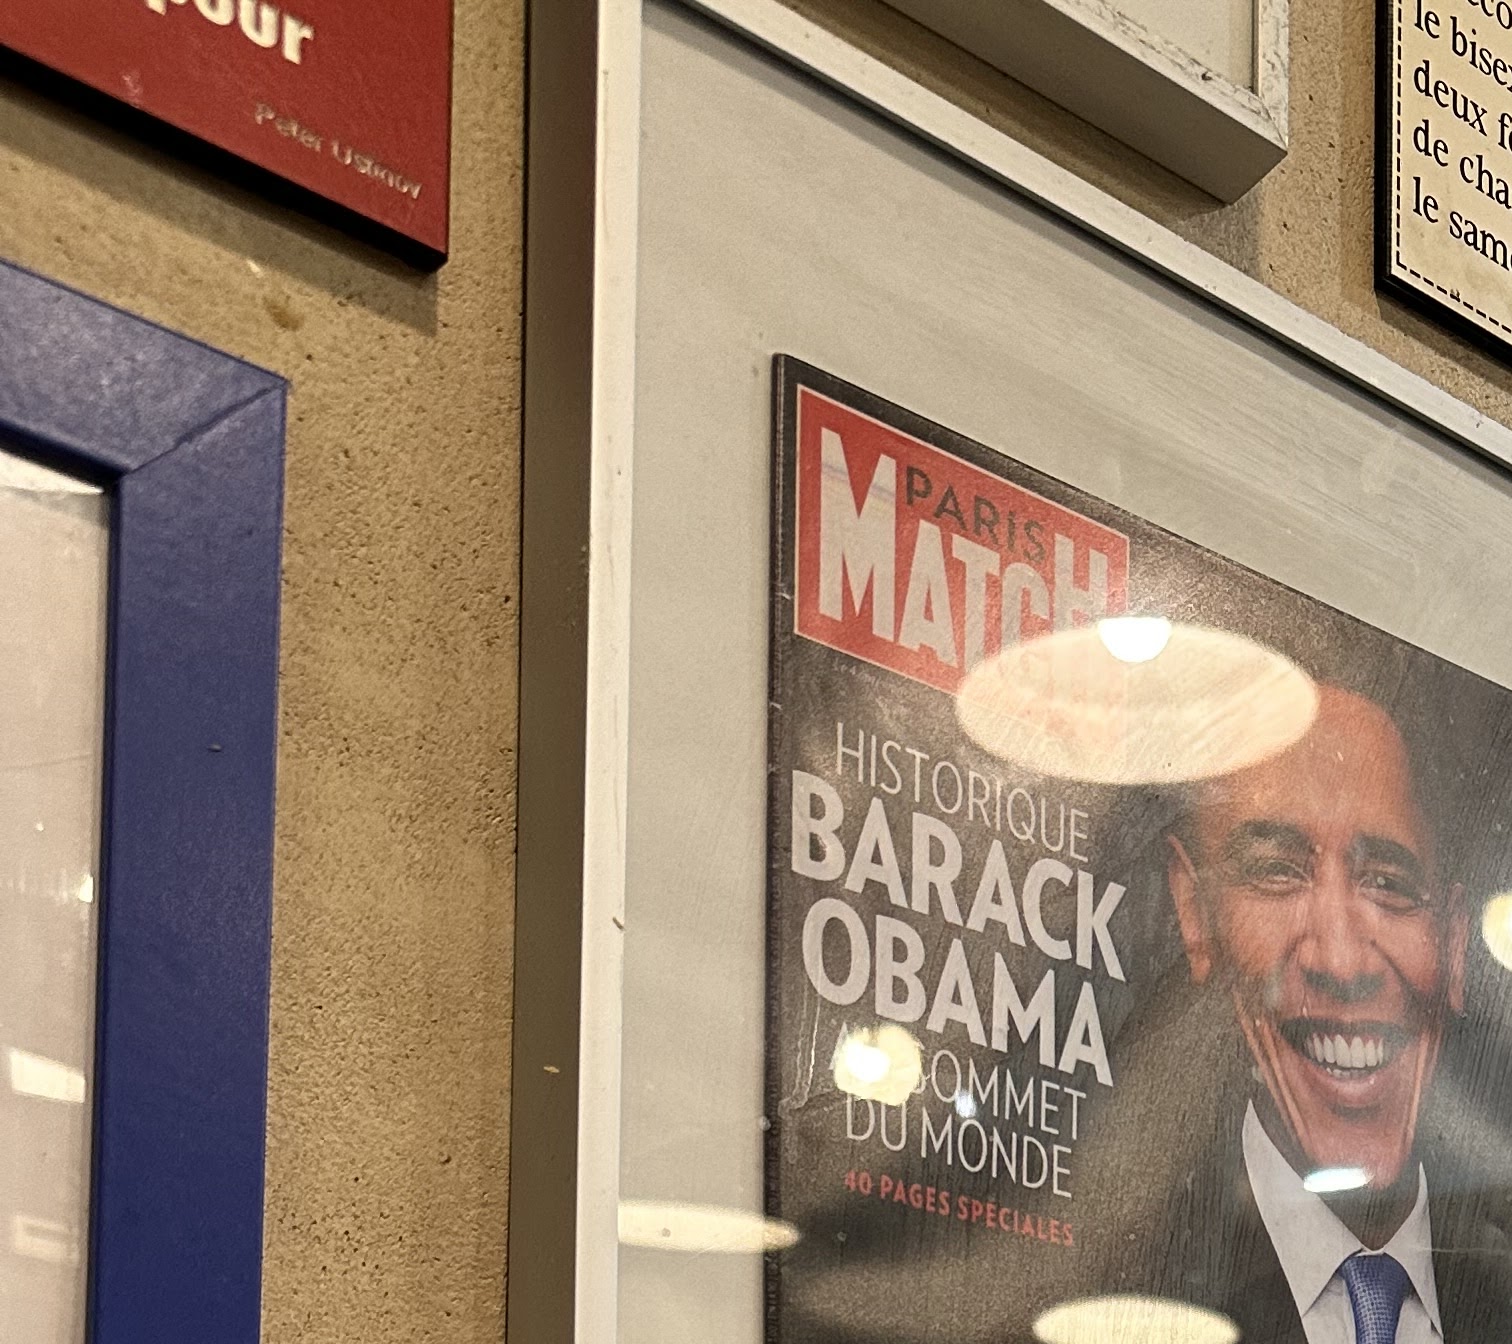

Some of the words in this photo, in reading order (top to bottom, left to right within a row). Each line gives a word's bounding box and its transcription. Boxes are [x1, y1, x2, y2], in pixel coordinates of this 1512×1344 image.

[1414, 0, 1440, 39] le
[1413, 118, 1448, 167] de
[1414, 59, 1488, 137] deux
[1412, 175, 1438, 224] le
[819, 426, 1108, 678] MATCH
[905, 466, 1045, 562] PARIS
[837, 722, 1089, 863] HISTORIQUE
[791, 770, 1127, 982] BARACK
[802, 898, 1114, 1087] OBAMA
[846, 1092, 907, 1152] DU
[921, 1107, 1073, 1199] MONDE
[845, 1170, 871, 1197] 40
[880, 1174, 951, 1218] PAGES
